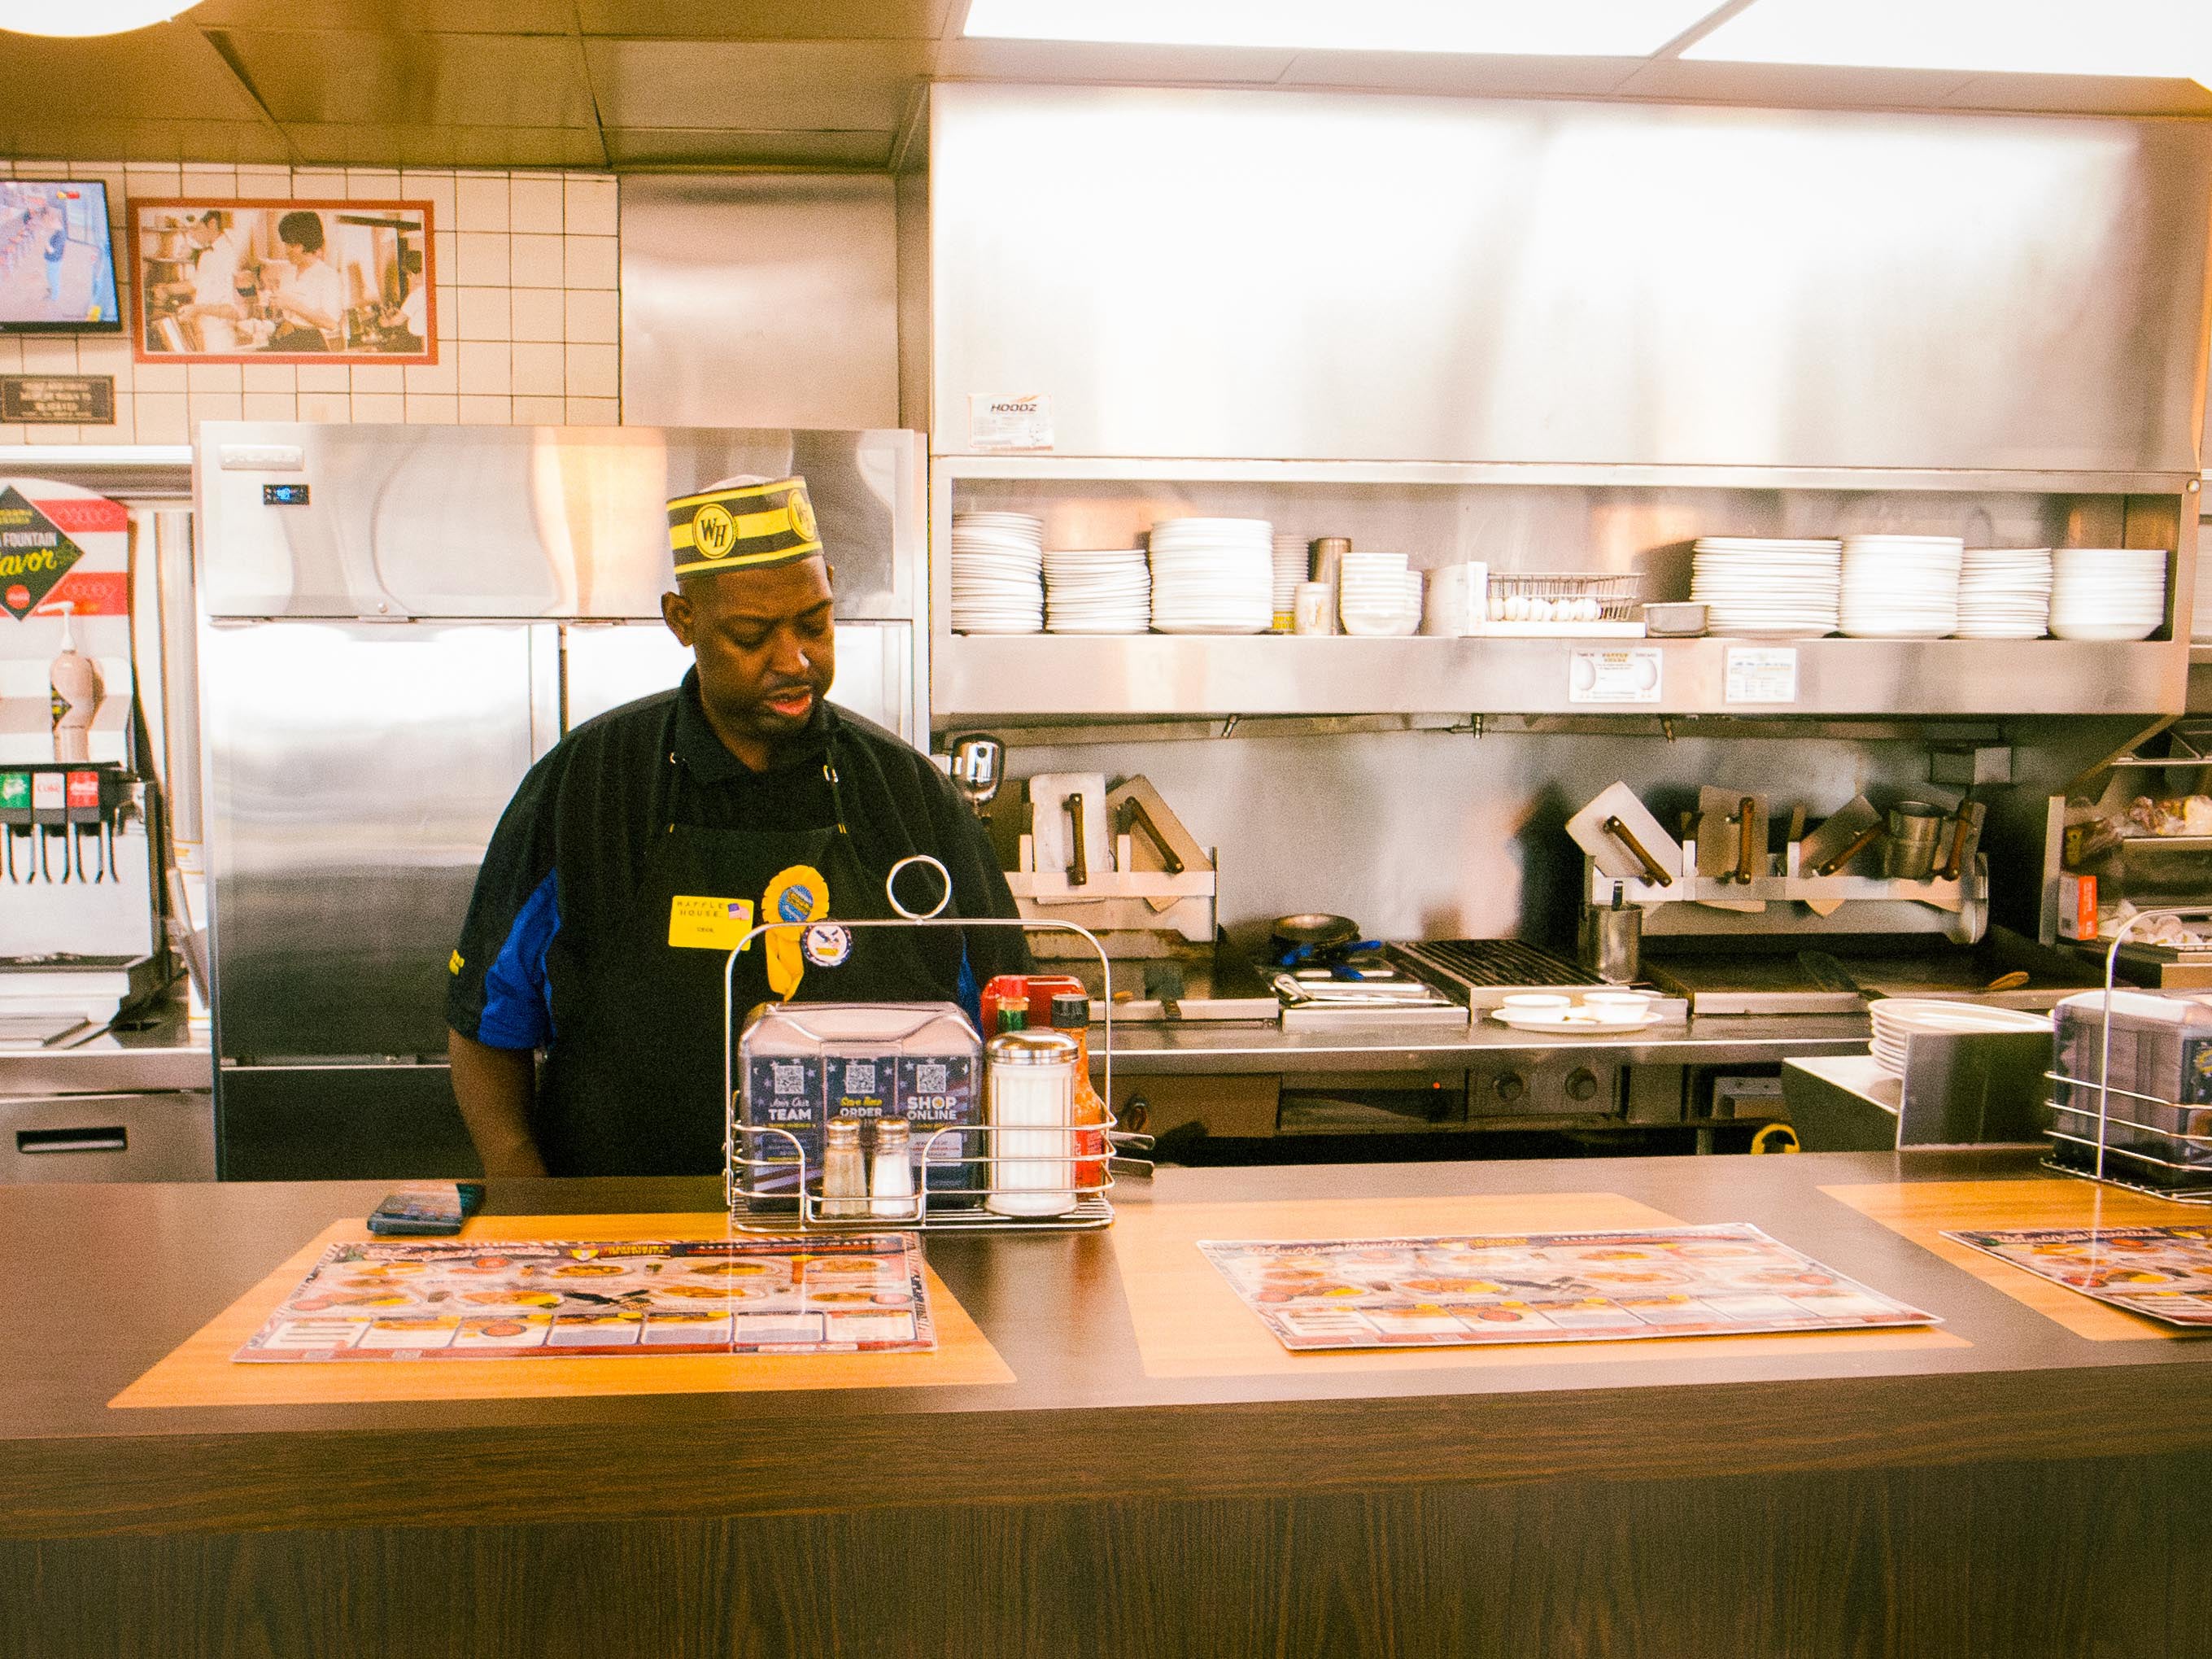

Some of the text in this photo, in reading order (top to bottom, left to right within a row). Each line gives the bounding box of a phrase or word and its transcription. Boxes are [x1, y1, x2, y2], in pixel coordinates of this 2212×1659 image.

[990, 403, 1037, 412] HOODZ
[700, 517, 728, 548] WH
[2, 532, 57, 547] FOUNTAIN
[0, 548, 57, 576] avor
[906, 1096, 957, 1110] SHOP
[768, 1108, 812, 1121] TEAM
[840, 1107, 883, 1118] ORDER
[906, 1110, 958, 1120] ONLINE
